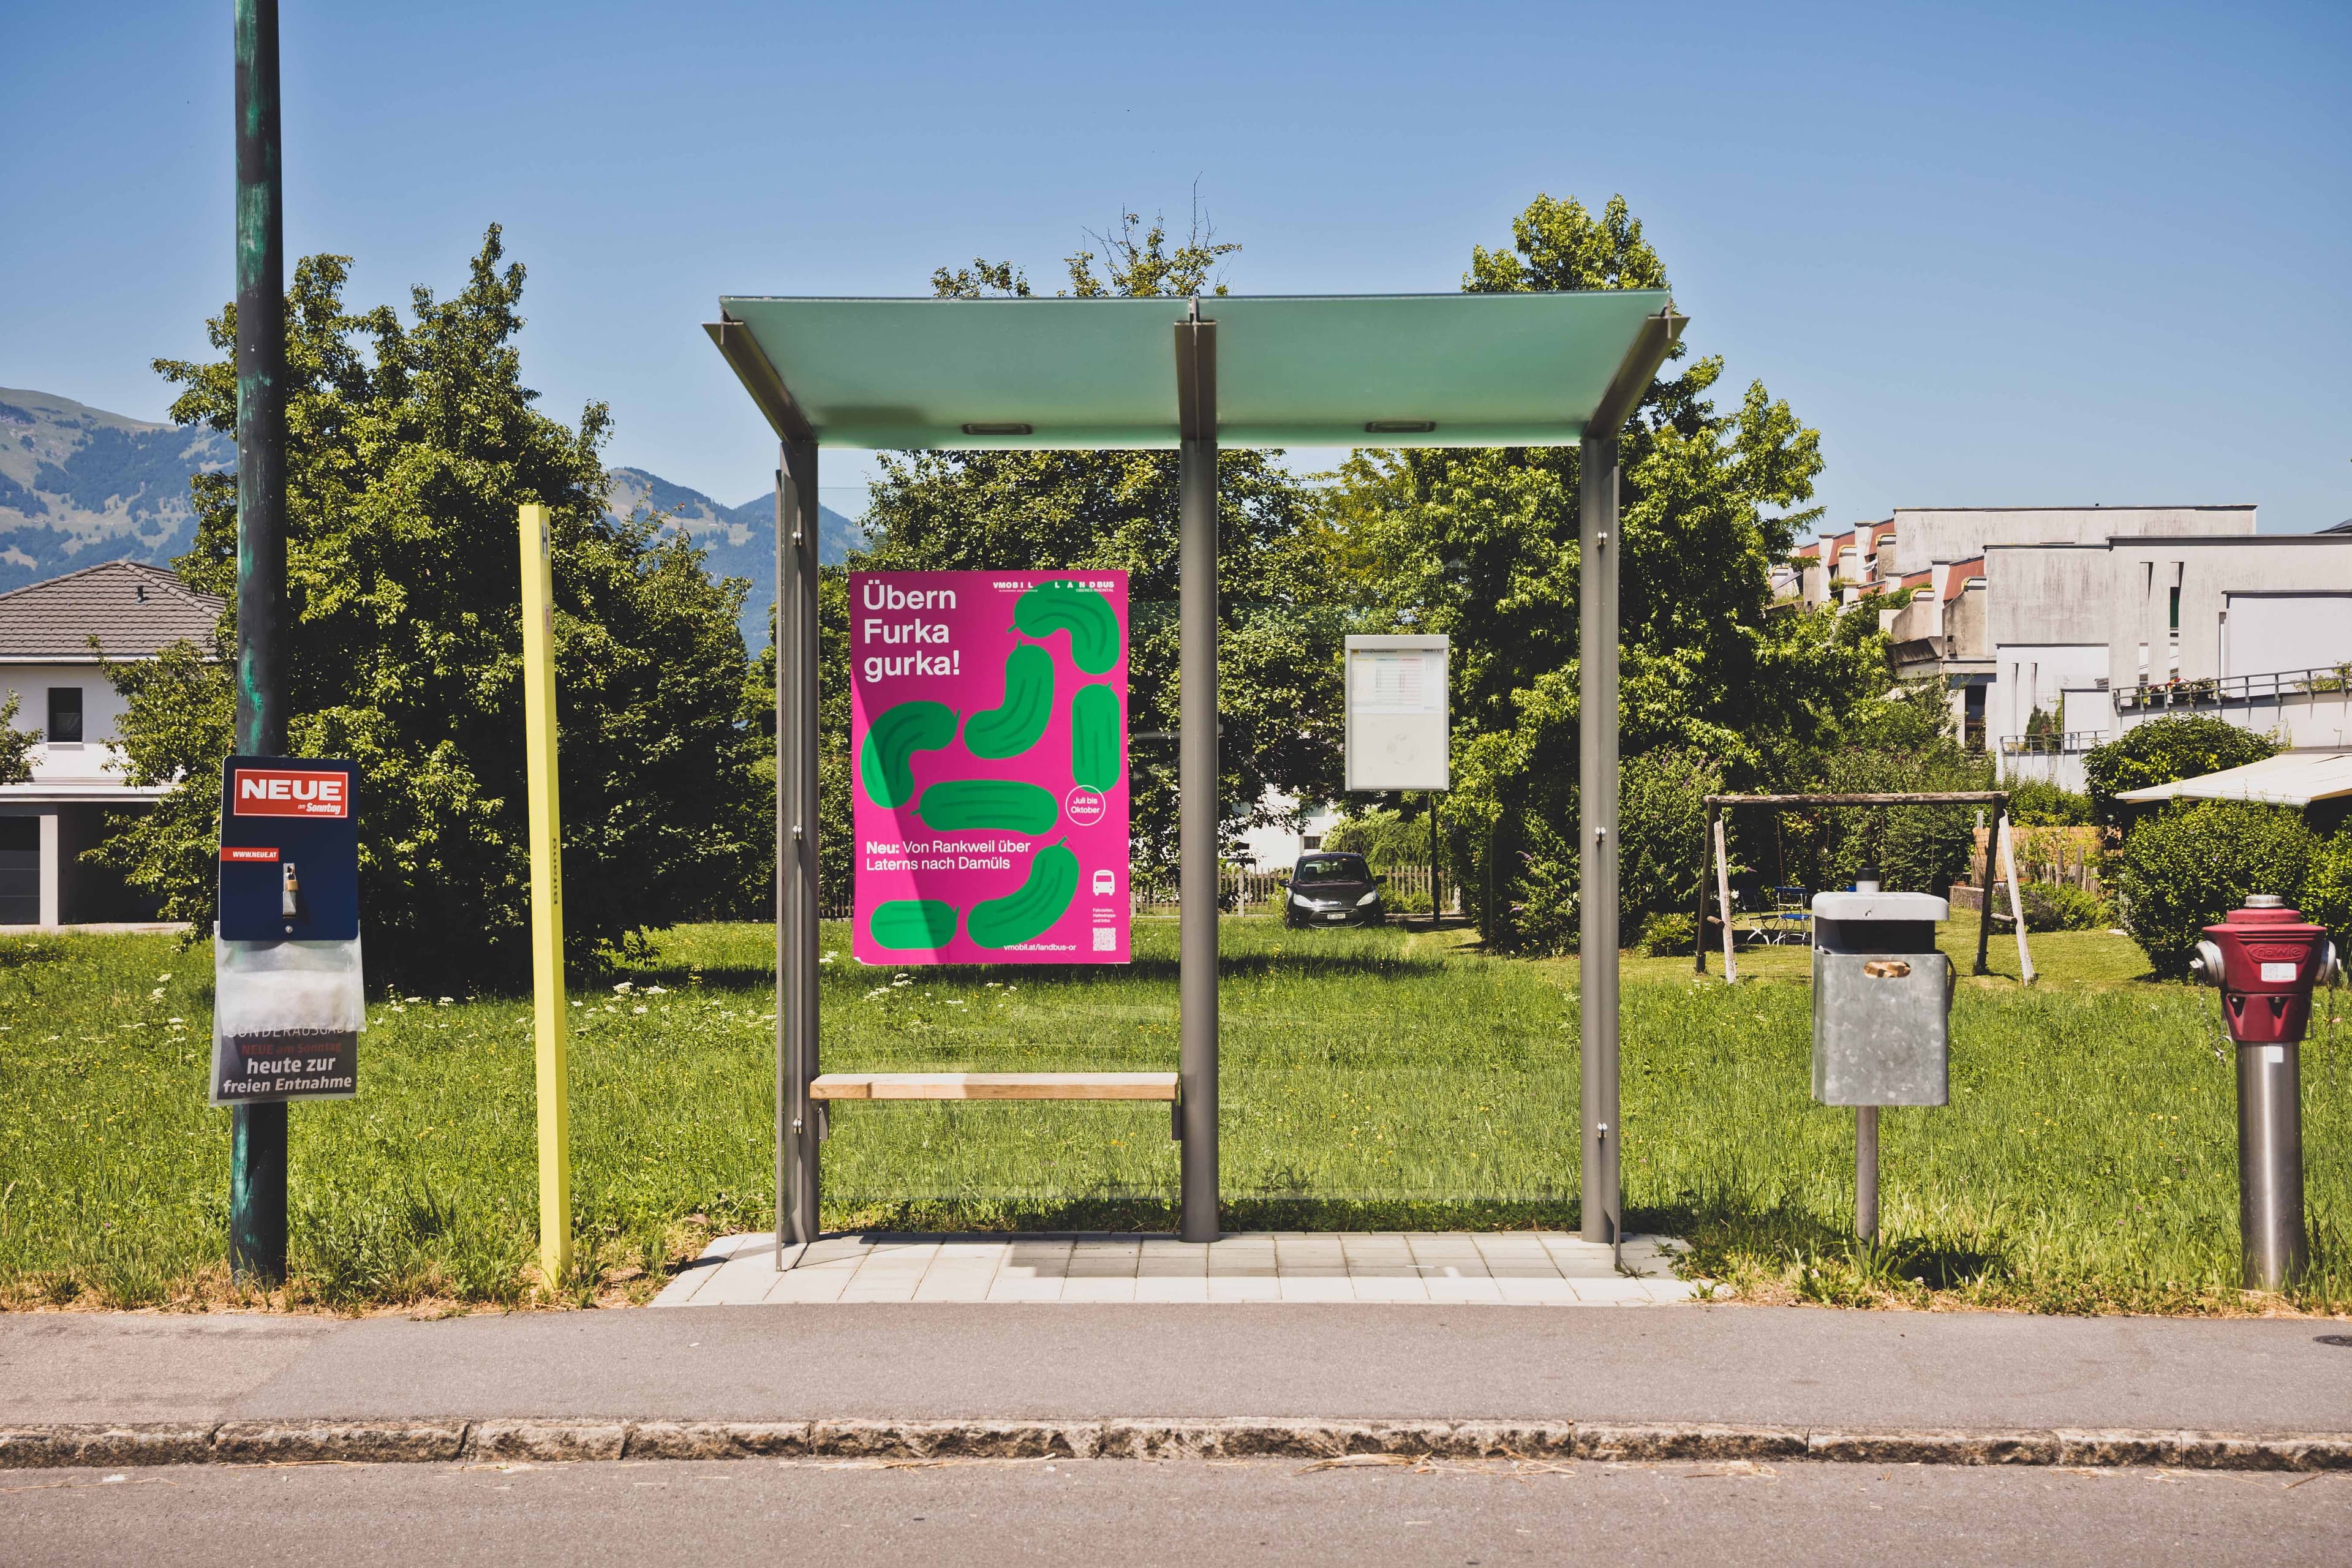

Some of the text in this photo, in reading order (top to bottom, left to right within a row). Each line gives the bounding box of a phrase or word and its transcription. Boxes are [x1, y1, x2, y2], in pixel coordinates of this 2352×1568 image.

[863, 579, 956, 610] Übern
[864, 618, 949, 644] Furka
[864, 650, 960, 683] gurka!
[241, 778, 342, 801] NEUE
[306, 802, 341, 815] Sonntag
[232, 850, 277, 859] WWW.NEUE.AT
[866, 840, 1031, 854] Neu: Von Rankweil über
[866, 856, 1010, 871] Laterns nach Damüls
[241, 1041, 342, 1055] NEUE am Sonntag
[246, 1057, 336, 1074] heute zur
[223, 1076, 352, 1093] freien Entnahme
